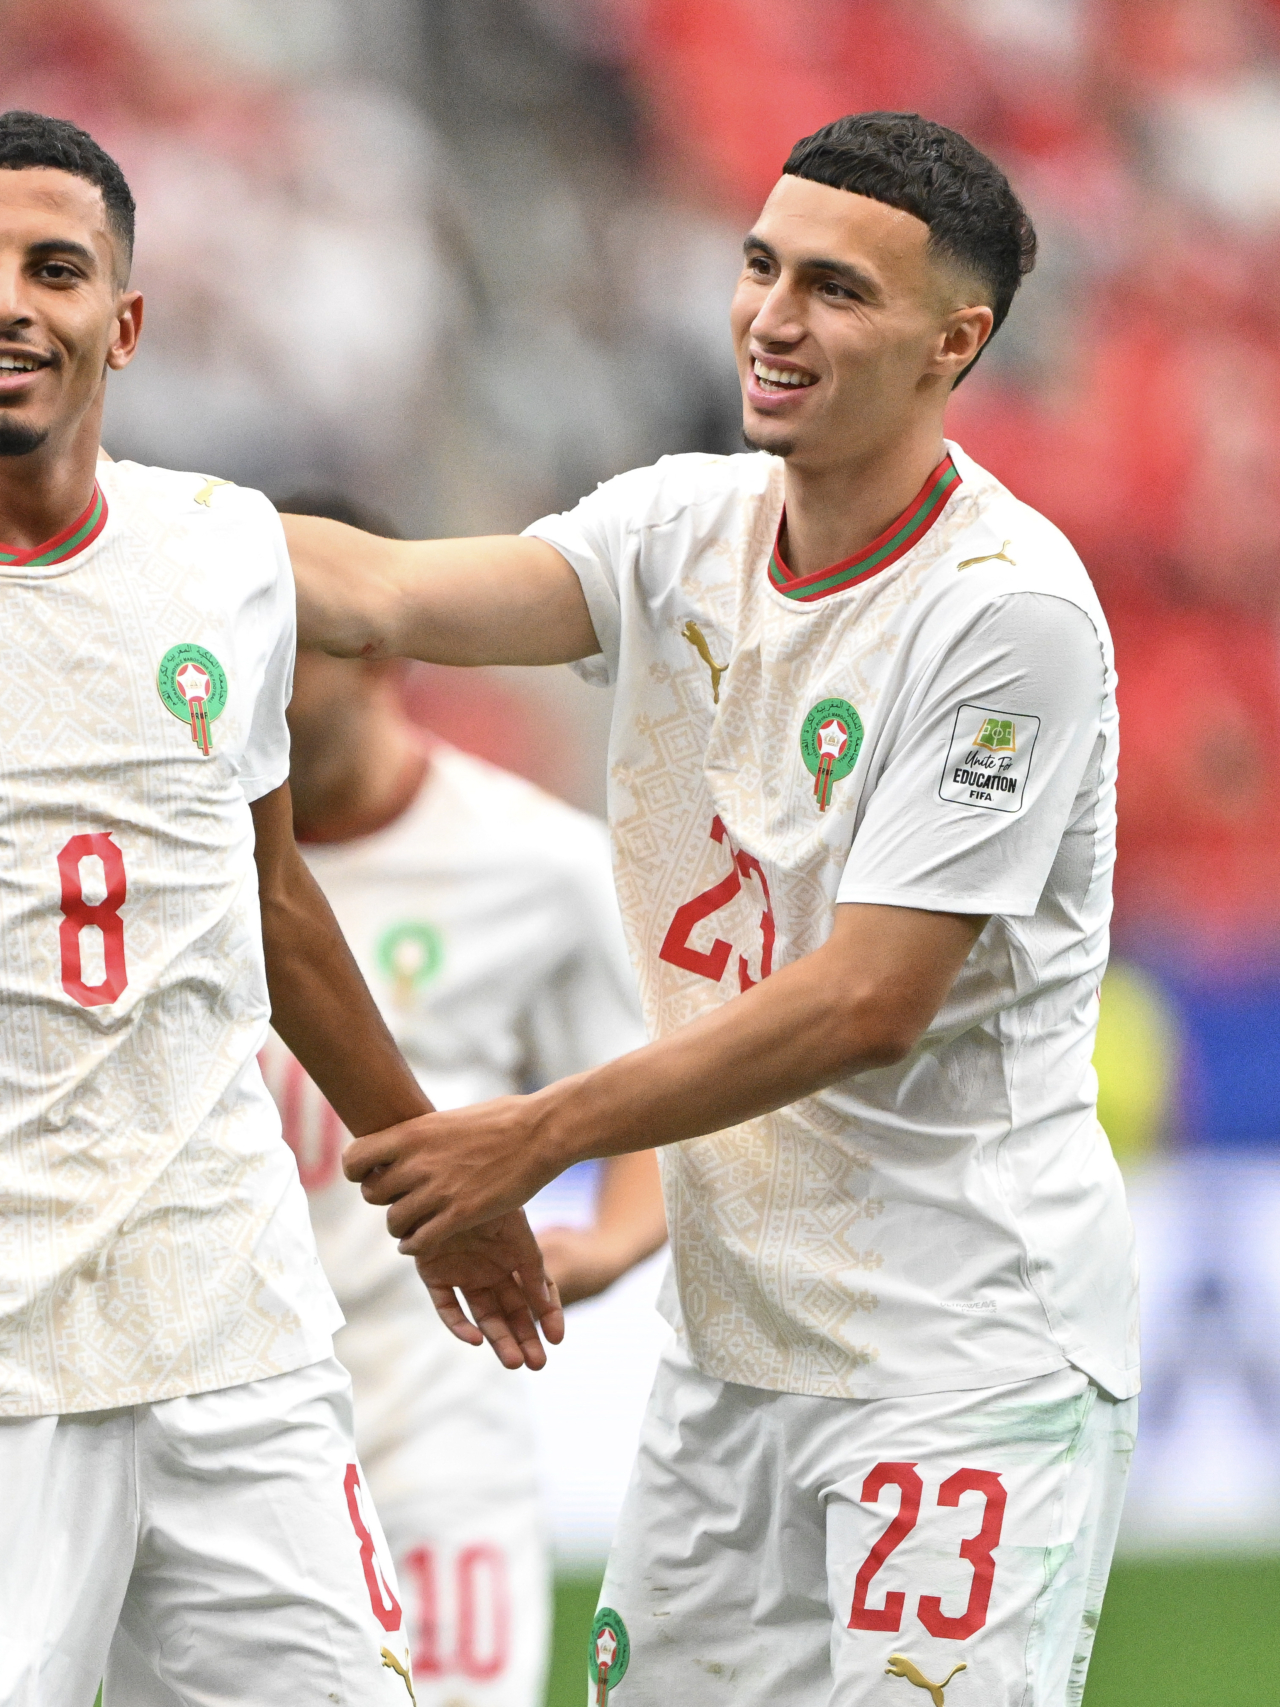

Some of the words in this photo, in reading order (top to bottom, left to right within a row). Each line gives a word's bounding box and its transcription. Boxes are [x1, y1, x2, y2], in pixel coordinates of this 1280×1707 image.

[953, 767, 1017, 794] EDUCATION
[965, 751, 996, 769] Unite
[997, 756, 1012, 773] For
[969, 790, 992, 802] FIFA
[56, 831, 129, 1008] 8
[256, 1047, 343, 1190] 0
[343, 1463, 402, 1632] 8
[402, 1545, 511, 1682] 10
[847, 1461, 1008, 1640] 23
